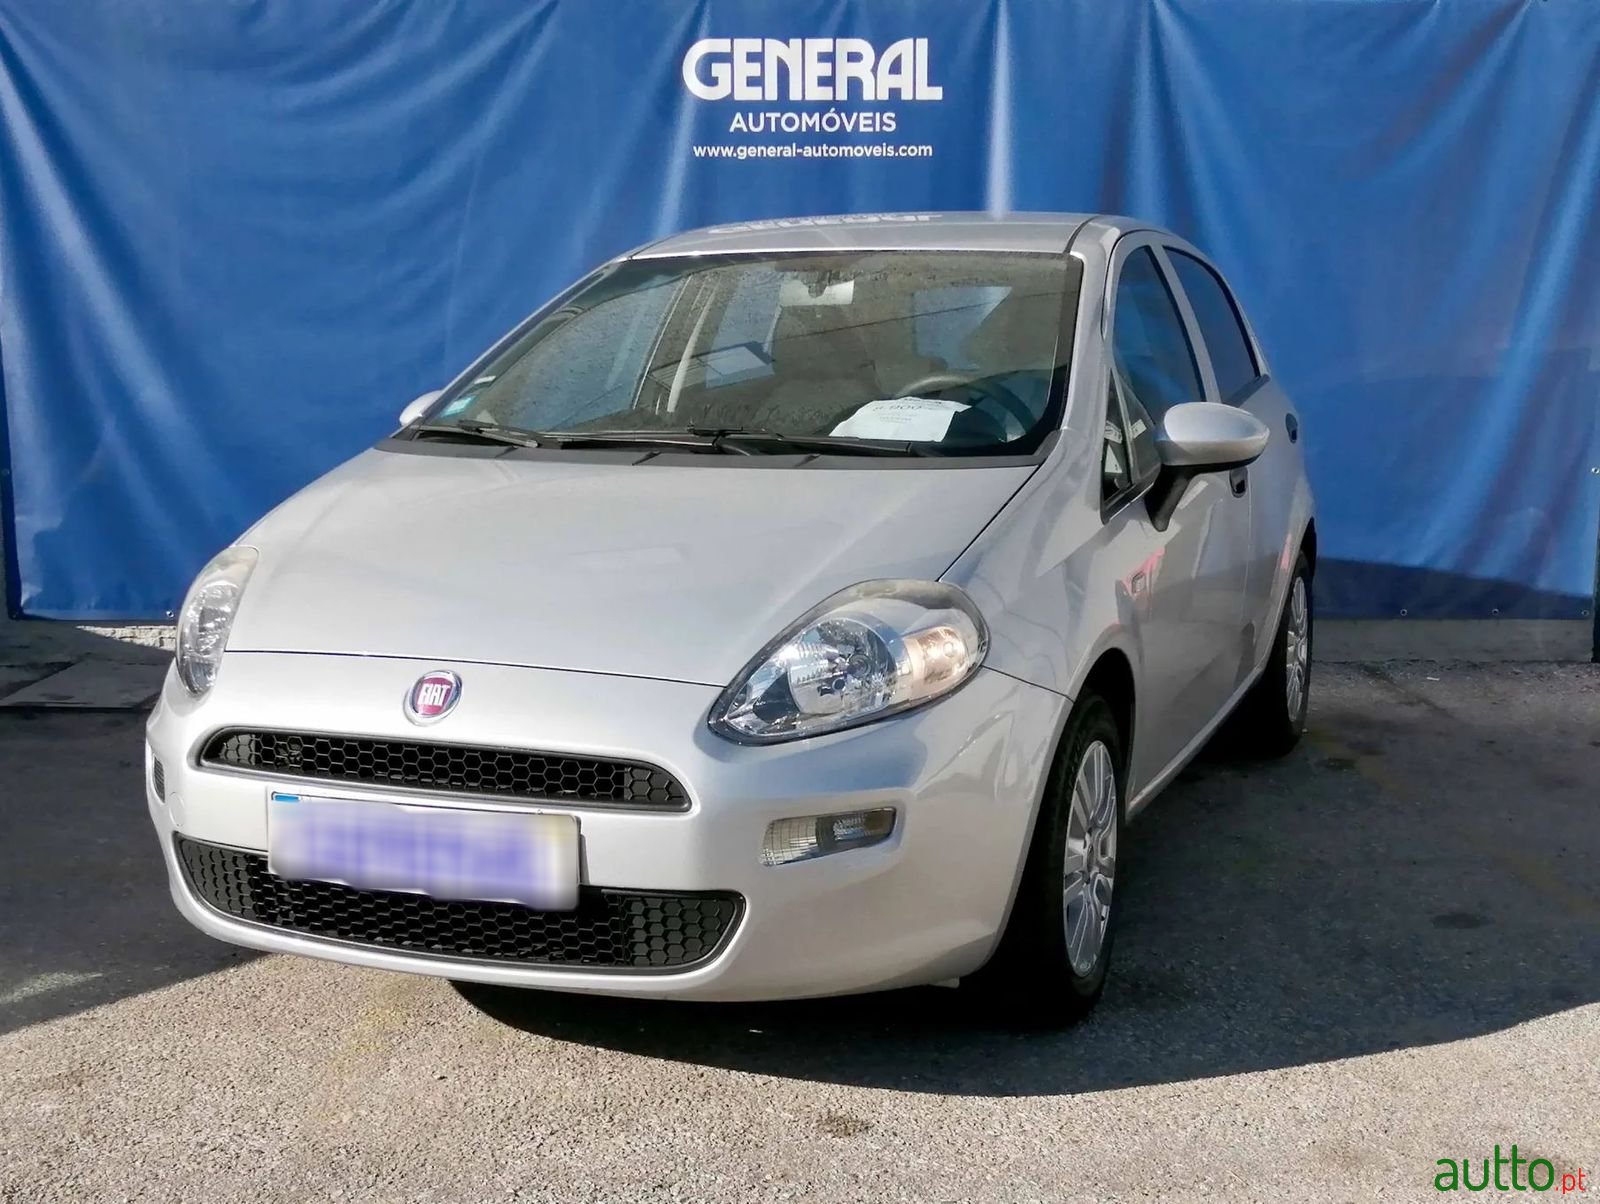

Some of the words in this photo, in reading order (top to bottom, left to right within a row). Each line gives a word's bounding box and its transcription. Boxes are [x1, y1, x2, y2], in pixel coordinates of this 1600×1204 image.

[682, 38, 943, 101] GENERAL
[729, 108, 897, 132] AUTOMÓVEIS
[693, 143, 933, 159] www.general-automoveis.com
[417, 683, 451, 706] FIAT
